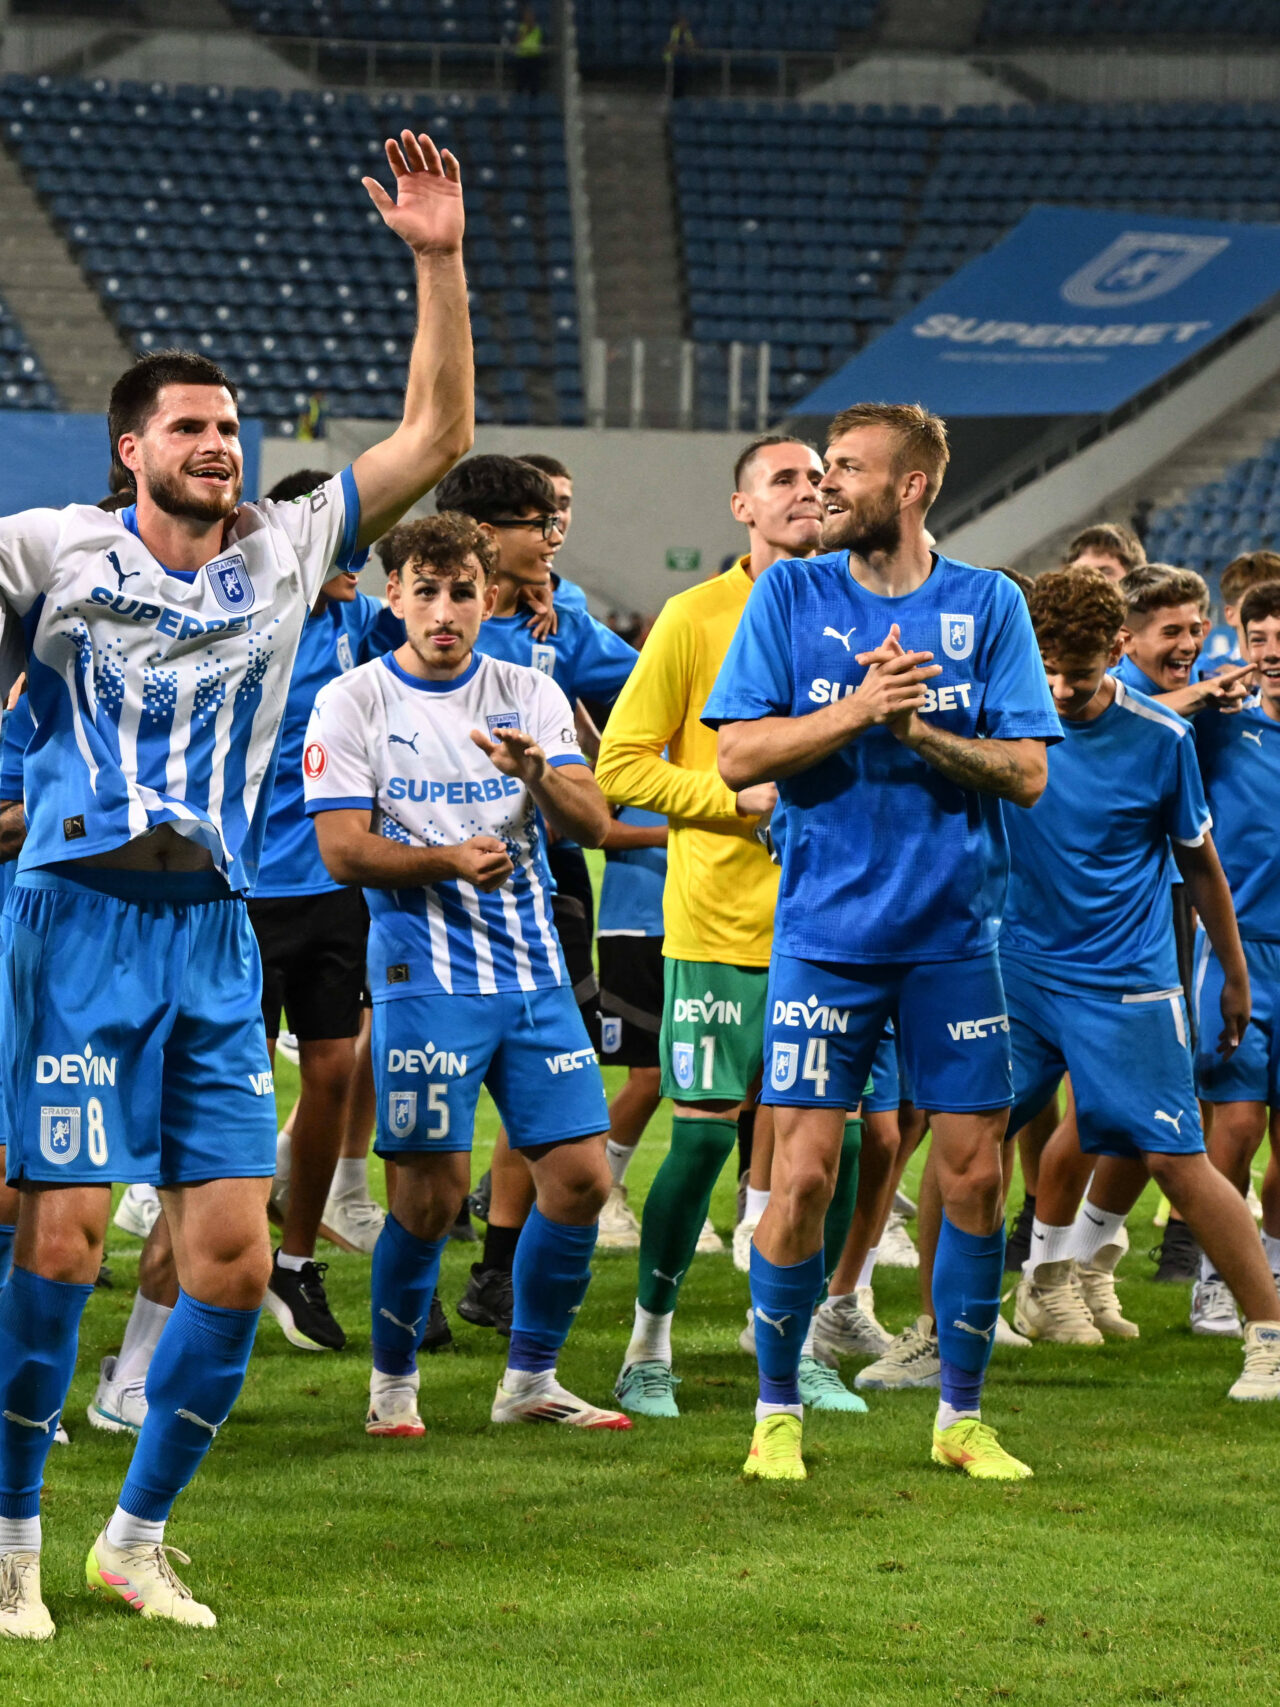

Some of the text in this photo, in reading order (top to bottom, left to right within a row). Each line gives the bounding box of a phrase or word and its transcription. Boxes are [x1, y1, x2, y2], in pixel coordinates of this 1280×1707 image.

[913, 313, 1211, 347] SUPERBET
[208, 556, 241, 572] CRAIOVA
[808, 677, 971, 713] SUBET
[386, 775, 521, 804] SUPERBE
[672, 990, 742, 1026] DEVIN
[772, 994, 851, 1034] DEVIN
[35, 1042, 118, 1087] DEVIN
[388, 1040, 469, 1077] DEVIN
[699, 1035, 716, 1090] 1
[802, 1037, 830, 1097] 4
[41, 1107, 80, 1116] CRAIOVA
[427, 1082, 450, 1140] 5
[87, 1096, 109, 1167] 8
